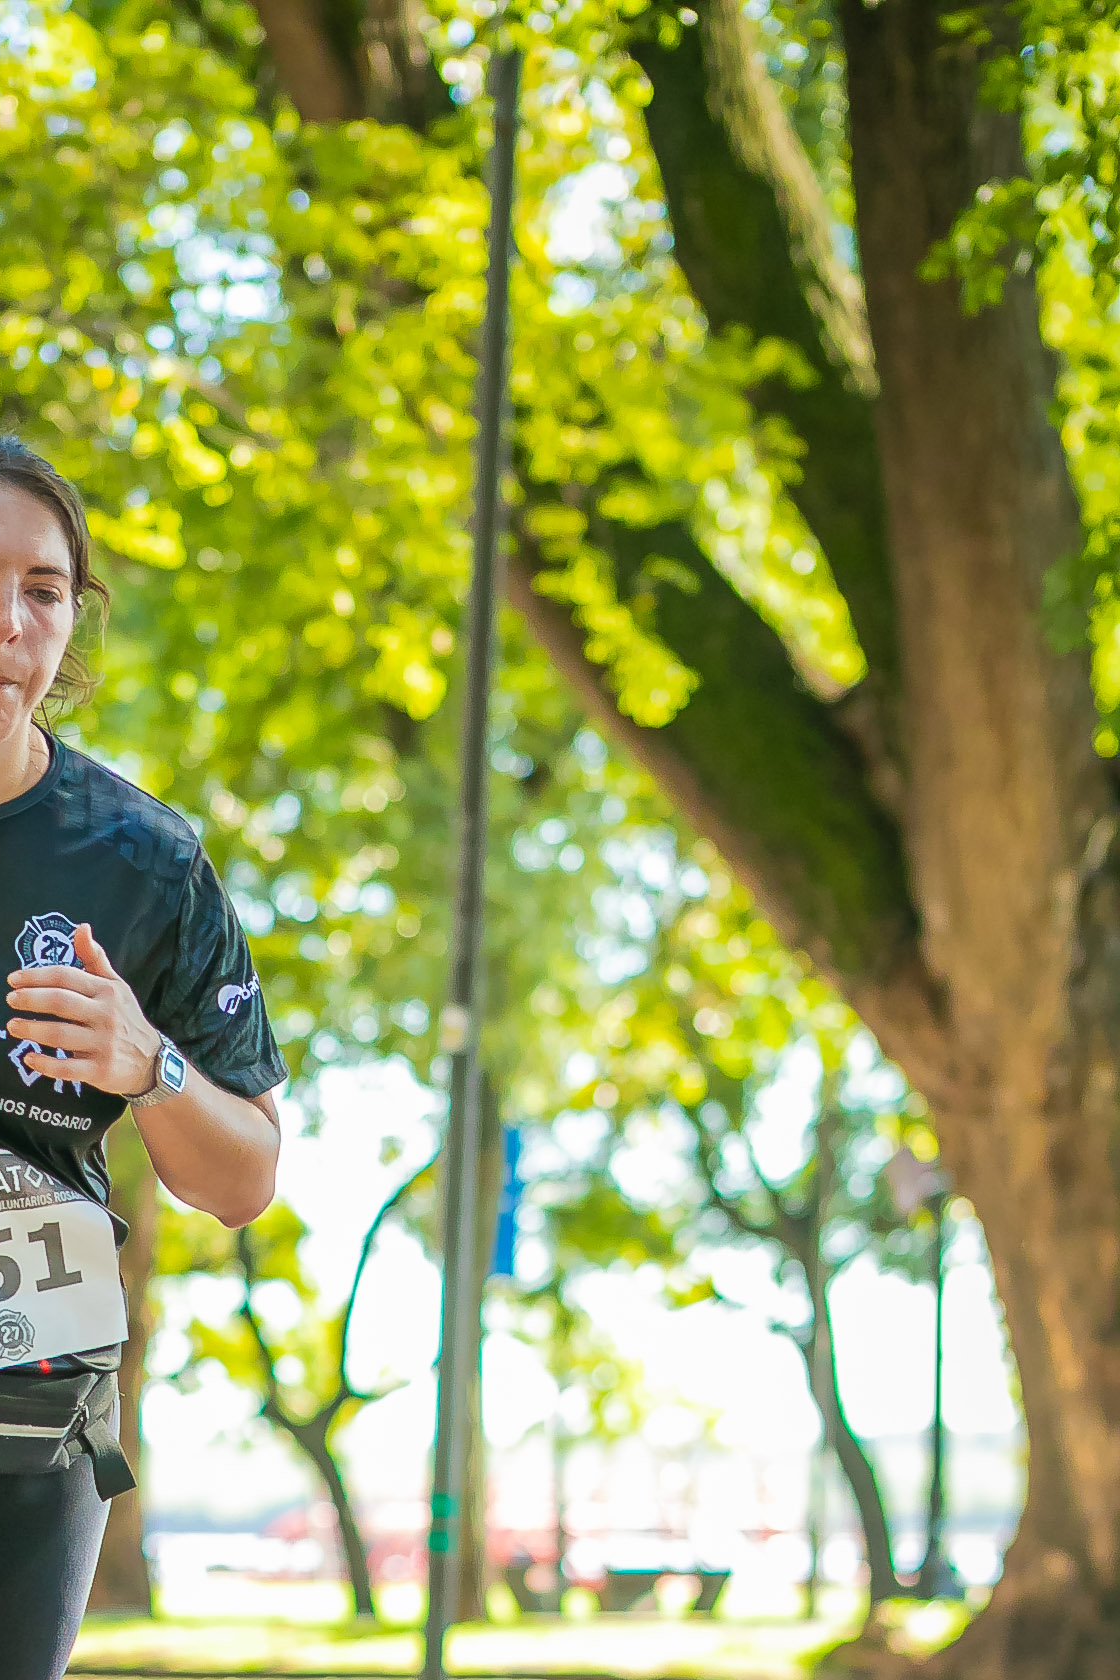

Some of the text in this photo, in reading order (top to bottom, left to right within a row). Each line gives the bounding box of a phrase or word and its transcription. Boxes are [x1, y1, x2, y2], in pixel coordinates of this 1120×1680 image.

[40, 934, 70, 962] 27
[28, 1105, 92, 1131] ROSARIO
[0, 1325, 20, 1345] 27
